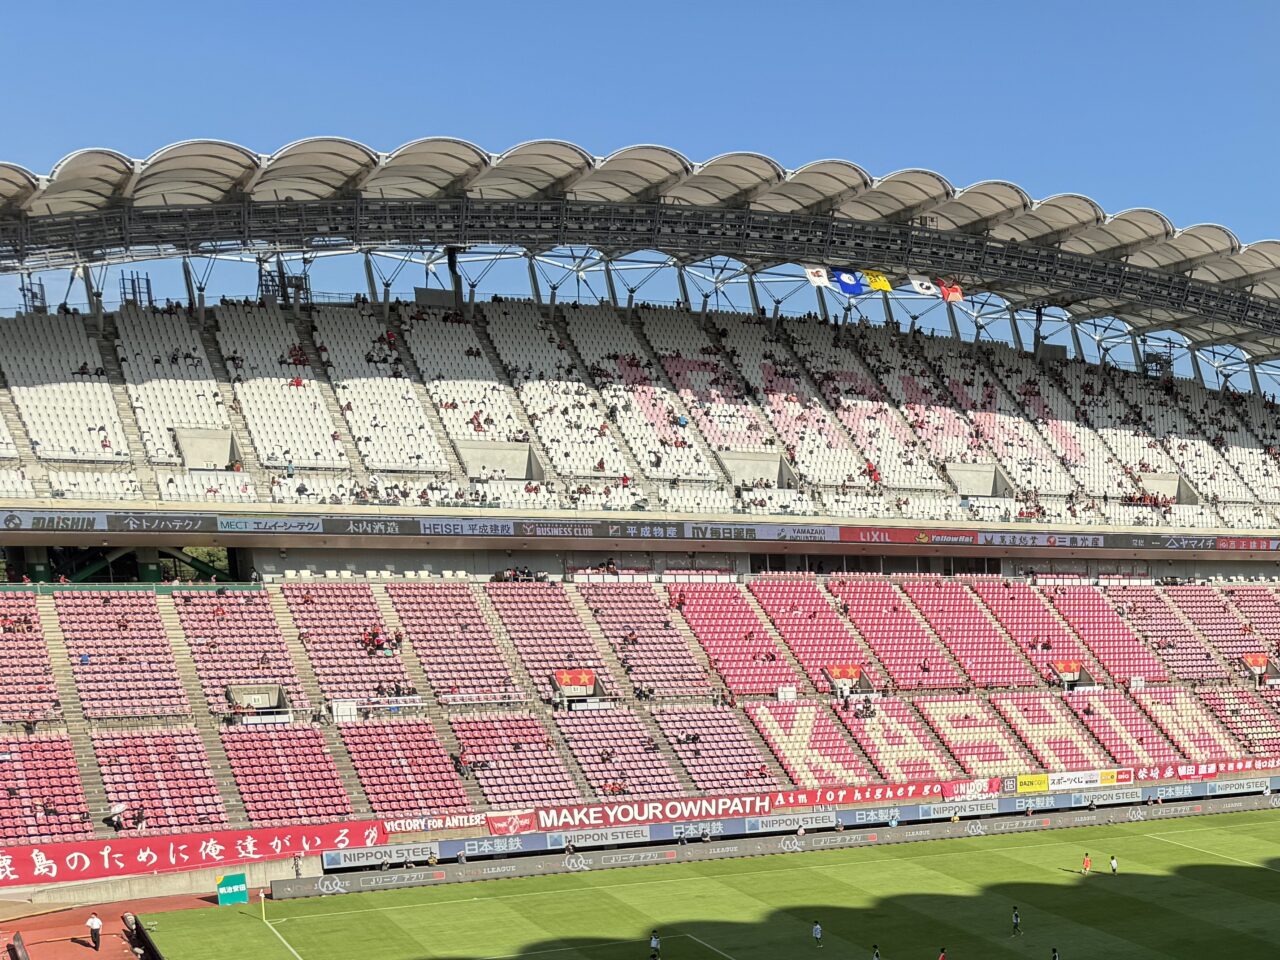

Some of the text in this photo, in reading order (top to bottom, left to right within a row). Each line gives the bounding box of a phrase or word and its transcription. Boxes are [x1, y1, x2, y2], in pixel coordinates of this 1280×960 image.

[142, 519, 202, 530] トノハテクノ
[220, 520, 320, 531] MECT エムイーシーテクノ
[346, 520, 400, 534] 木内酒造
[423, 523, 464, 534] HEISEI
[536, 527, 593, 536] BUSINESS CLUB
[626, 525, 678, 538] 平成物産
[860, 530, 892, 542] LIXIL
[1180, 538, 1215, 549] ヤマイチ
[953, 780, 990, 795] UNIDOS
[1050, 776, 1083, 786] スポーツくじ
[775, 792, 808, 806] Aim
[815, 788, 847, 804] for
[853, 784, 916, 801] higher
[1157, 784, 1193, 798] 日本製鉄
[539, 796, 771, 829] MAKE YOUR OWN PATH
[932, 802, 997, 816] NIPPON STEEL
[384, 818, 425, 834] VICTORY
[426, 818, 444, 830] FOR
[444, 814, 487, 828] ANTLERS
[761, 815, 835, 829] NIPPON STEEL
[565, 829, 648, 846] NIPPON STEEL
[465, 837, 522, 855] 日本製鉄
[343, 847, 433, 863] NIPPON STEEL
